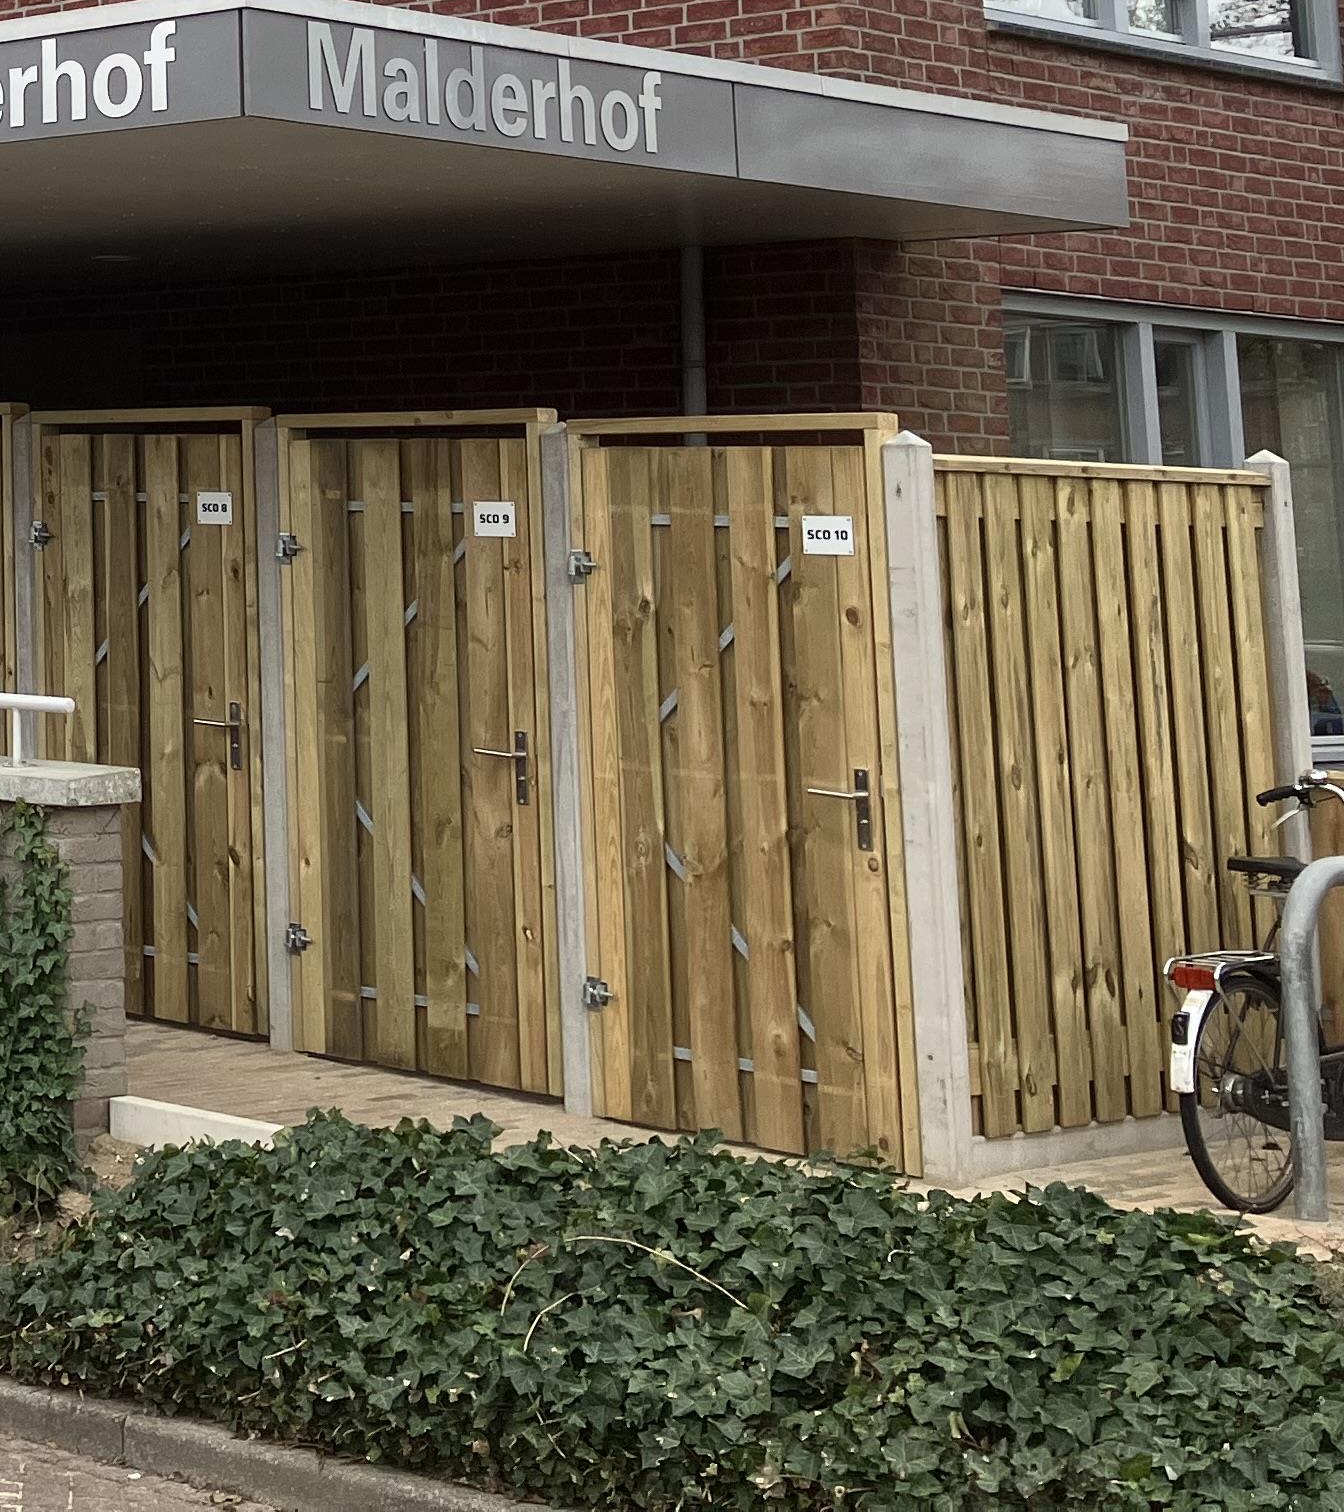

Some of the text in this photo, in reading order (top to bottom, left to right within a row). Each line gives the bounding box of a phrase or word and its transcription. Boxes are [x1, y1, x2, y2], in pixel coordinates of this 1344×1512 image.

[307, 20, 662, 154] Malderhof
[201, 503, 228, 513] SCO 8
[479, 514, 510, 524] SCO 9
[807, 529, 849, 541] SCO 10
